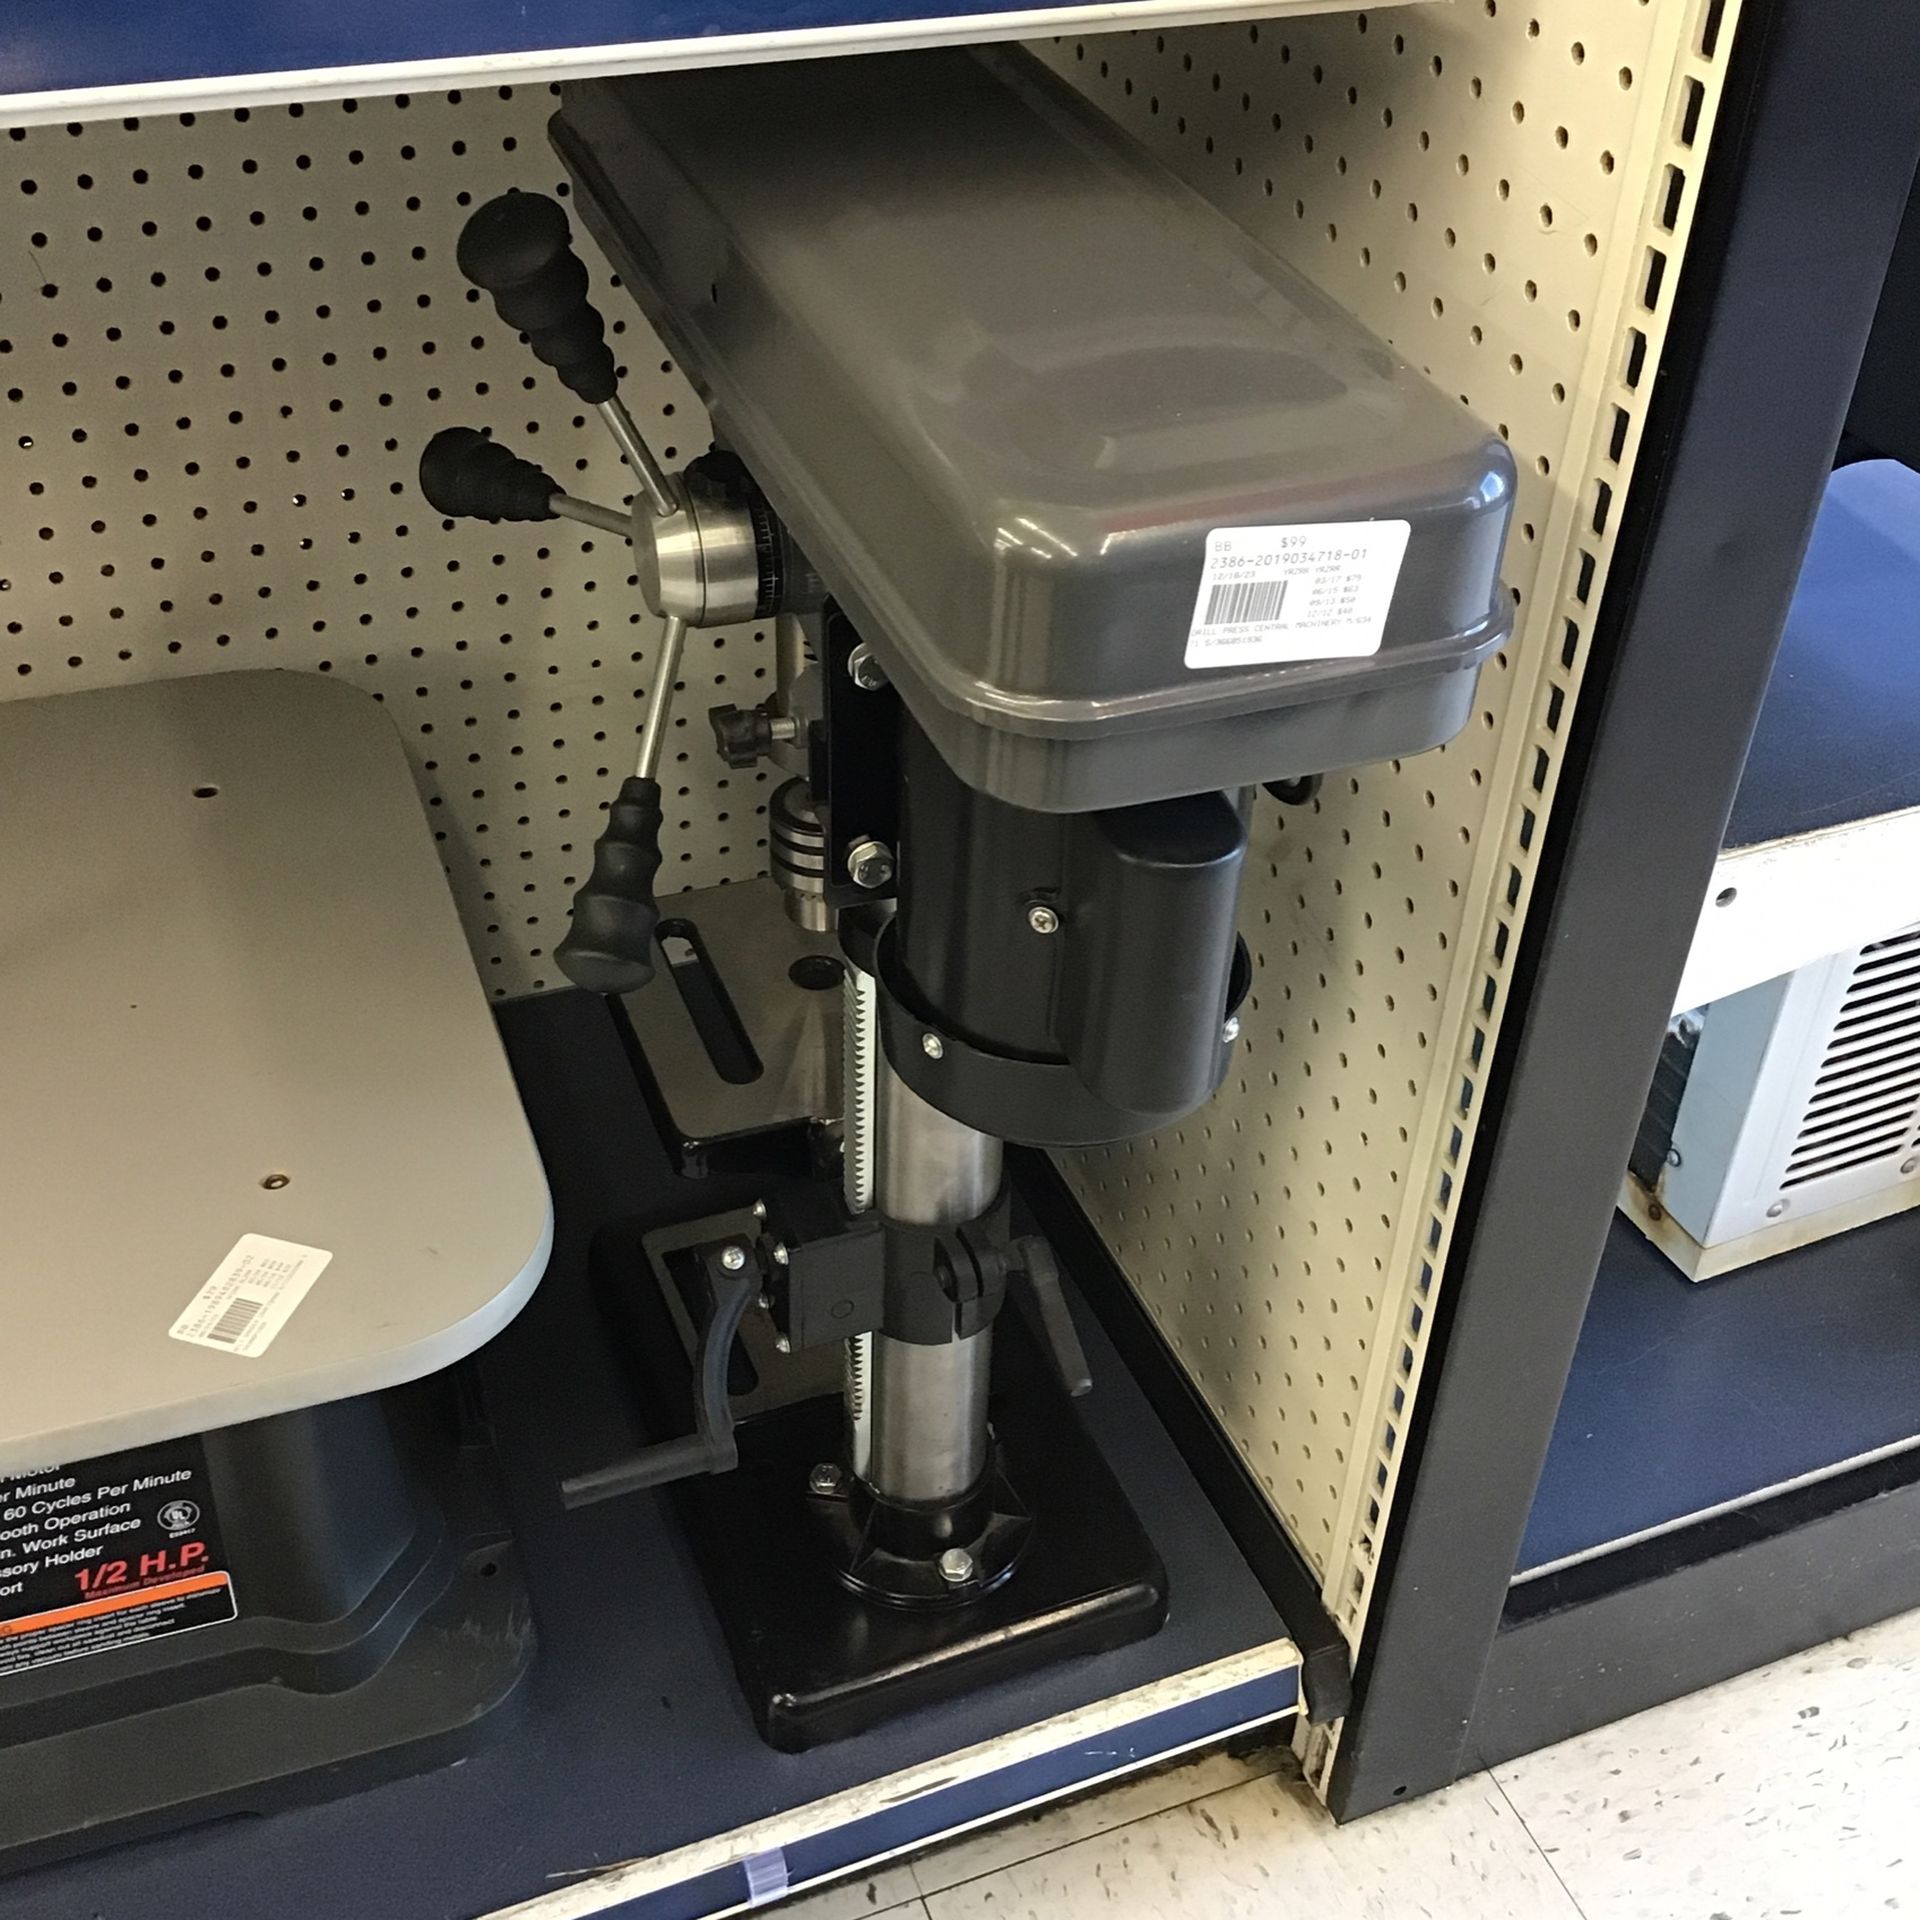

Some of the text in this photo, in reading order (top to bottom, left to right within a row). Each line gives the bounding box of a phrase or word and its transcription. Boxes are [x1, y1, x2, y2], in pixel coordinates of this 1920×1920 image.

[1214, 536, 1307, 552] BB $99
[1210, 549, 1367, 570] 2386-2019034718-01
[1222, 625, 1249, 635] PRESS
[1254, 623, 1289, 633] CENTRAL
[1295, 618, 1341, 630] MACHINERY
[4, 1468, 192, 1521] 60 Cycles Per Minute
[15, 1477, 76, 1500] Minute
[44, 1502, 131, 1530] Operation
[22, 1534, 69, 1554] Work
[74, 1518, 142, 1542] Surface
[0, 1545, 104, 1578] sory Holder
[75, 1541, 209, 1592] 1/2 H.P.
[0, 1581, 23, 1596] ort
